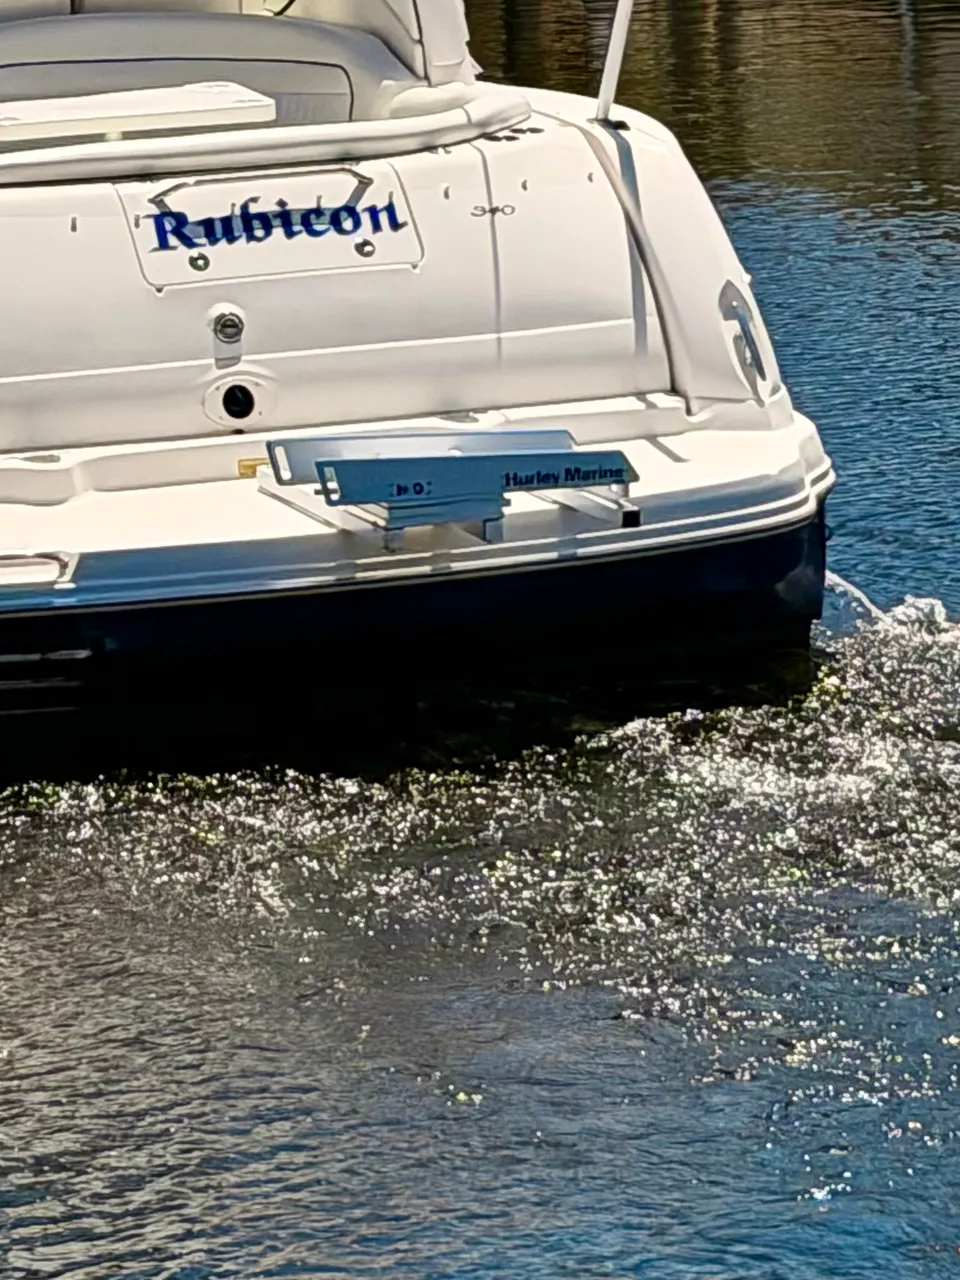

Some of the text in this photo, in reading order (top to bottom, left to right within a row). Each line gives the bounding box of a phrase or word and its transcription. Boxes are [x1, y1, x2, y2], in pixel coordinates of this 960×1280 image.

[143, 191, 409, 252] Rubicon
[503, 465, 625, 487] Hurley Marine
